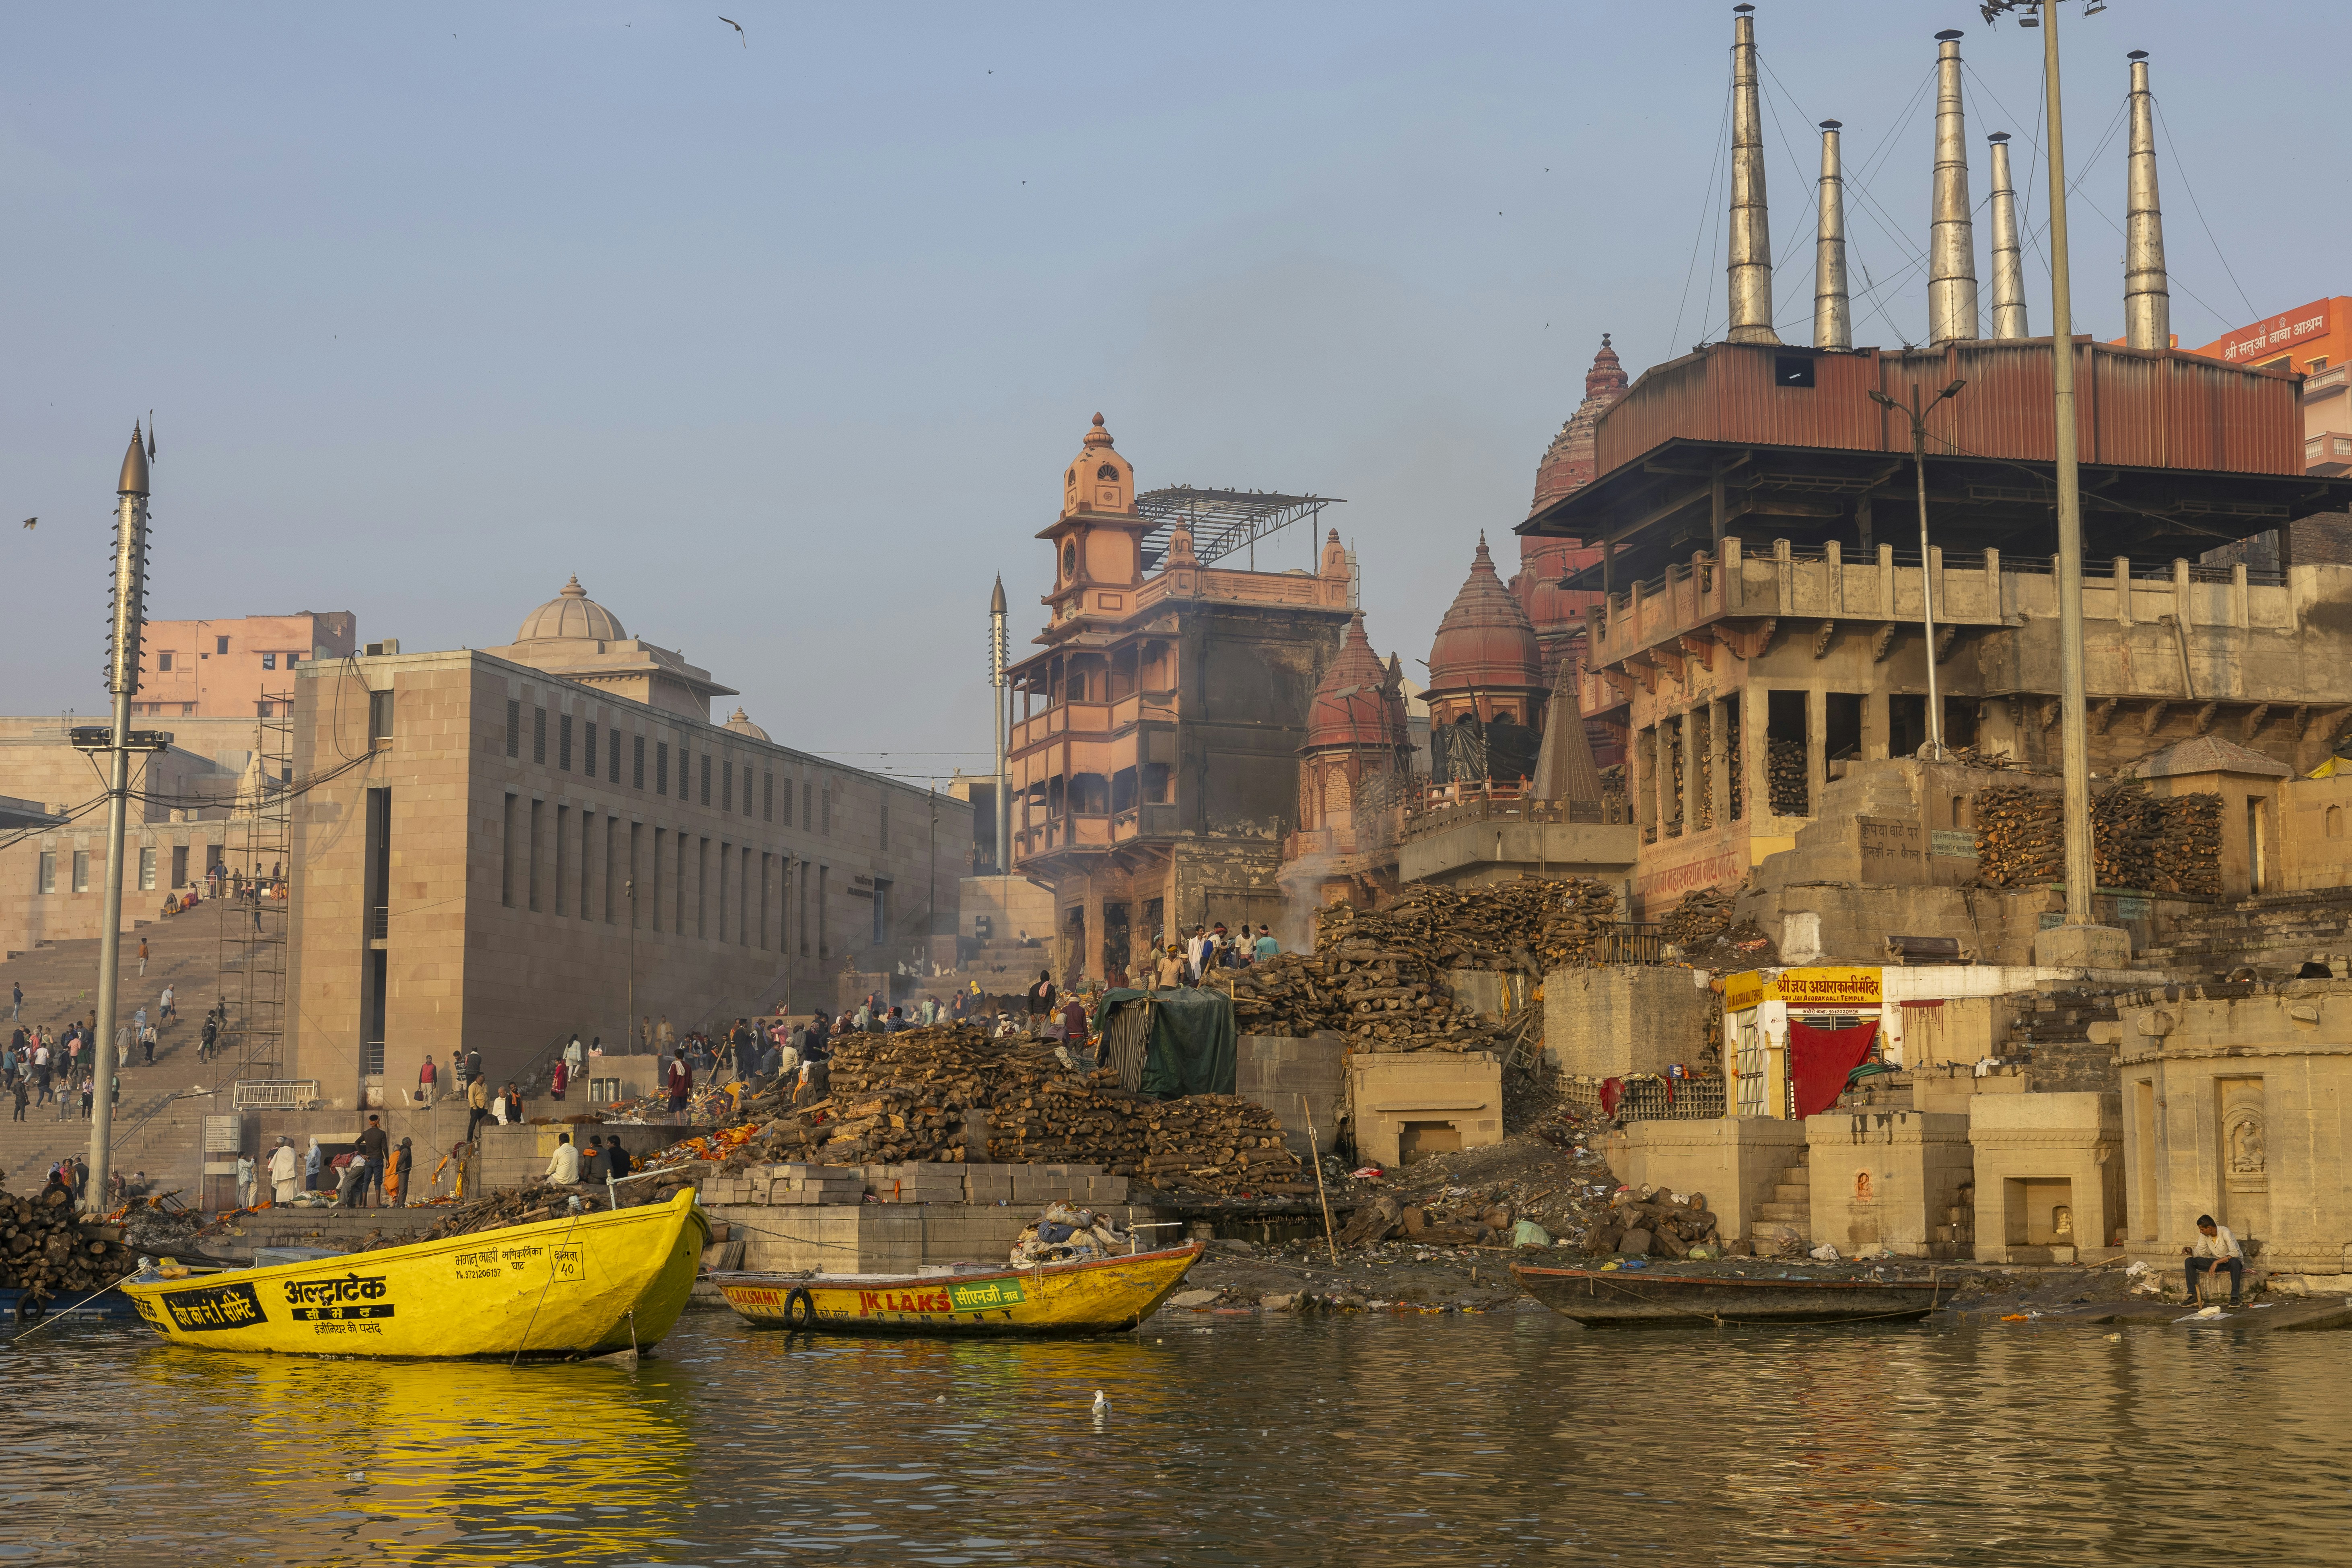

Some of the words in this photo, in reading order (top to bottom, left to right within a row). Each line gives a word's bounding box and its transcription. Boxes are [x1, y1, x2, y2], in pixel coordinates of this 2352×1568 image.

[2224, 341, 2237, 361] श्री
[2239, 336, 2266, 356] सतुआ
[2270, 327, 2291, 344] बाबा
[2293, 315, 2323, 336] आश्रम
[1777, 973, 1790, 993] श्री
[502, 1246, 543, 1260] मणिकर्णिका
[554, 1251, 579, 1263] क्षमता
[511, 1262, 525, 1270] घाट
[284, 1272, 387, 1306] अल्ट्राटेक
[730, 1290, 780, 1306] LAKSHMI
[955, 1284, 1001, 1305] सीएनजी
[1003, 1291, 1019, 1301] नाव
[169, 1300, 192, 1326] देश
[188, 1306, 207, 1324] का
[859, 1291, 884, 1317] JK
[886, 1293, 952, 1312] LAKS
[314, 1322, 346, 1335] इंजीनियर
[347, 1321, 357, 1333] की
[359, 1321, 383, 1335] पसंद
